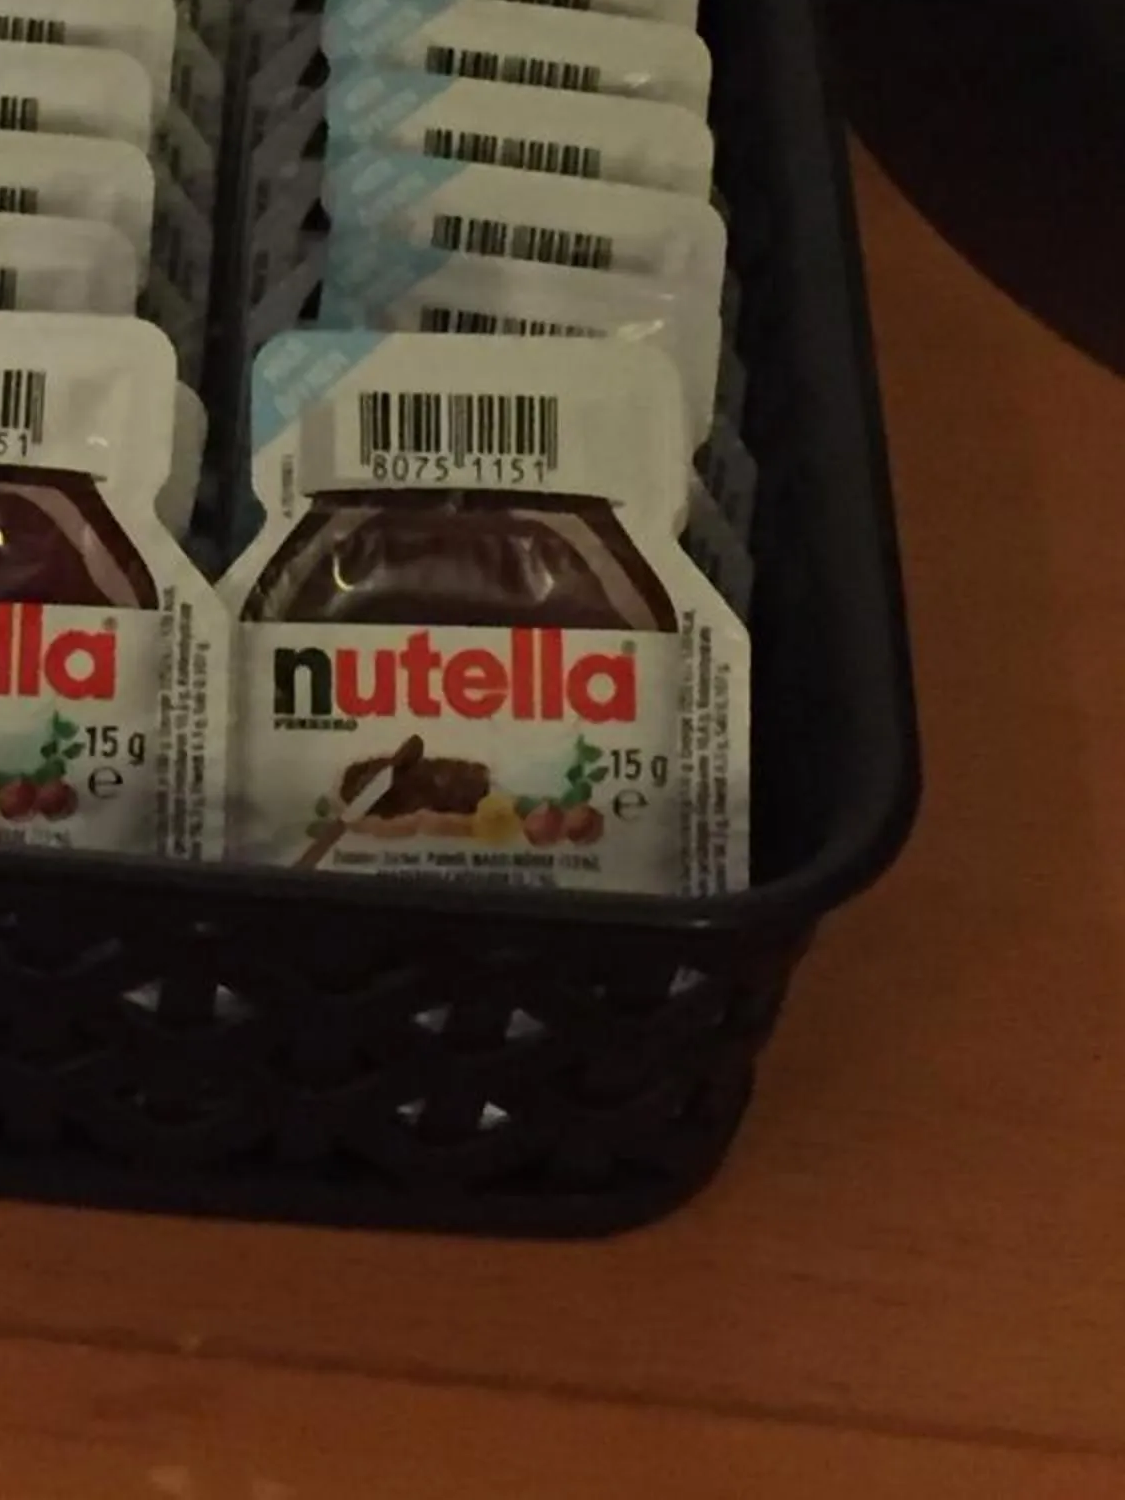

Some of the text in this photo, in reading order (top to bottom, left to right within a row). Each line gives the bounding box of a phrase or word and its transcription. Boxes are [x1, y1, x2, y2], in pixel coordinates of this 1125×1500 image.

[373, 454, 544, 484] 8075 1151
[273, 626, 636, 724] nutella
[86, 725, 145, 766] 15 g
[611, 748, 668, 789] 15 g
